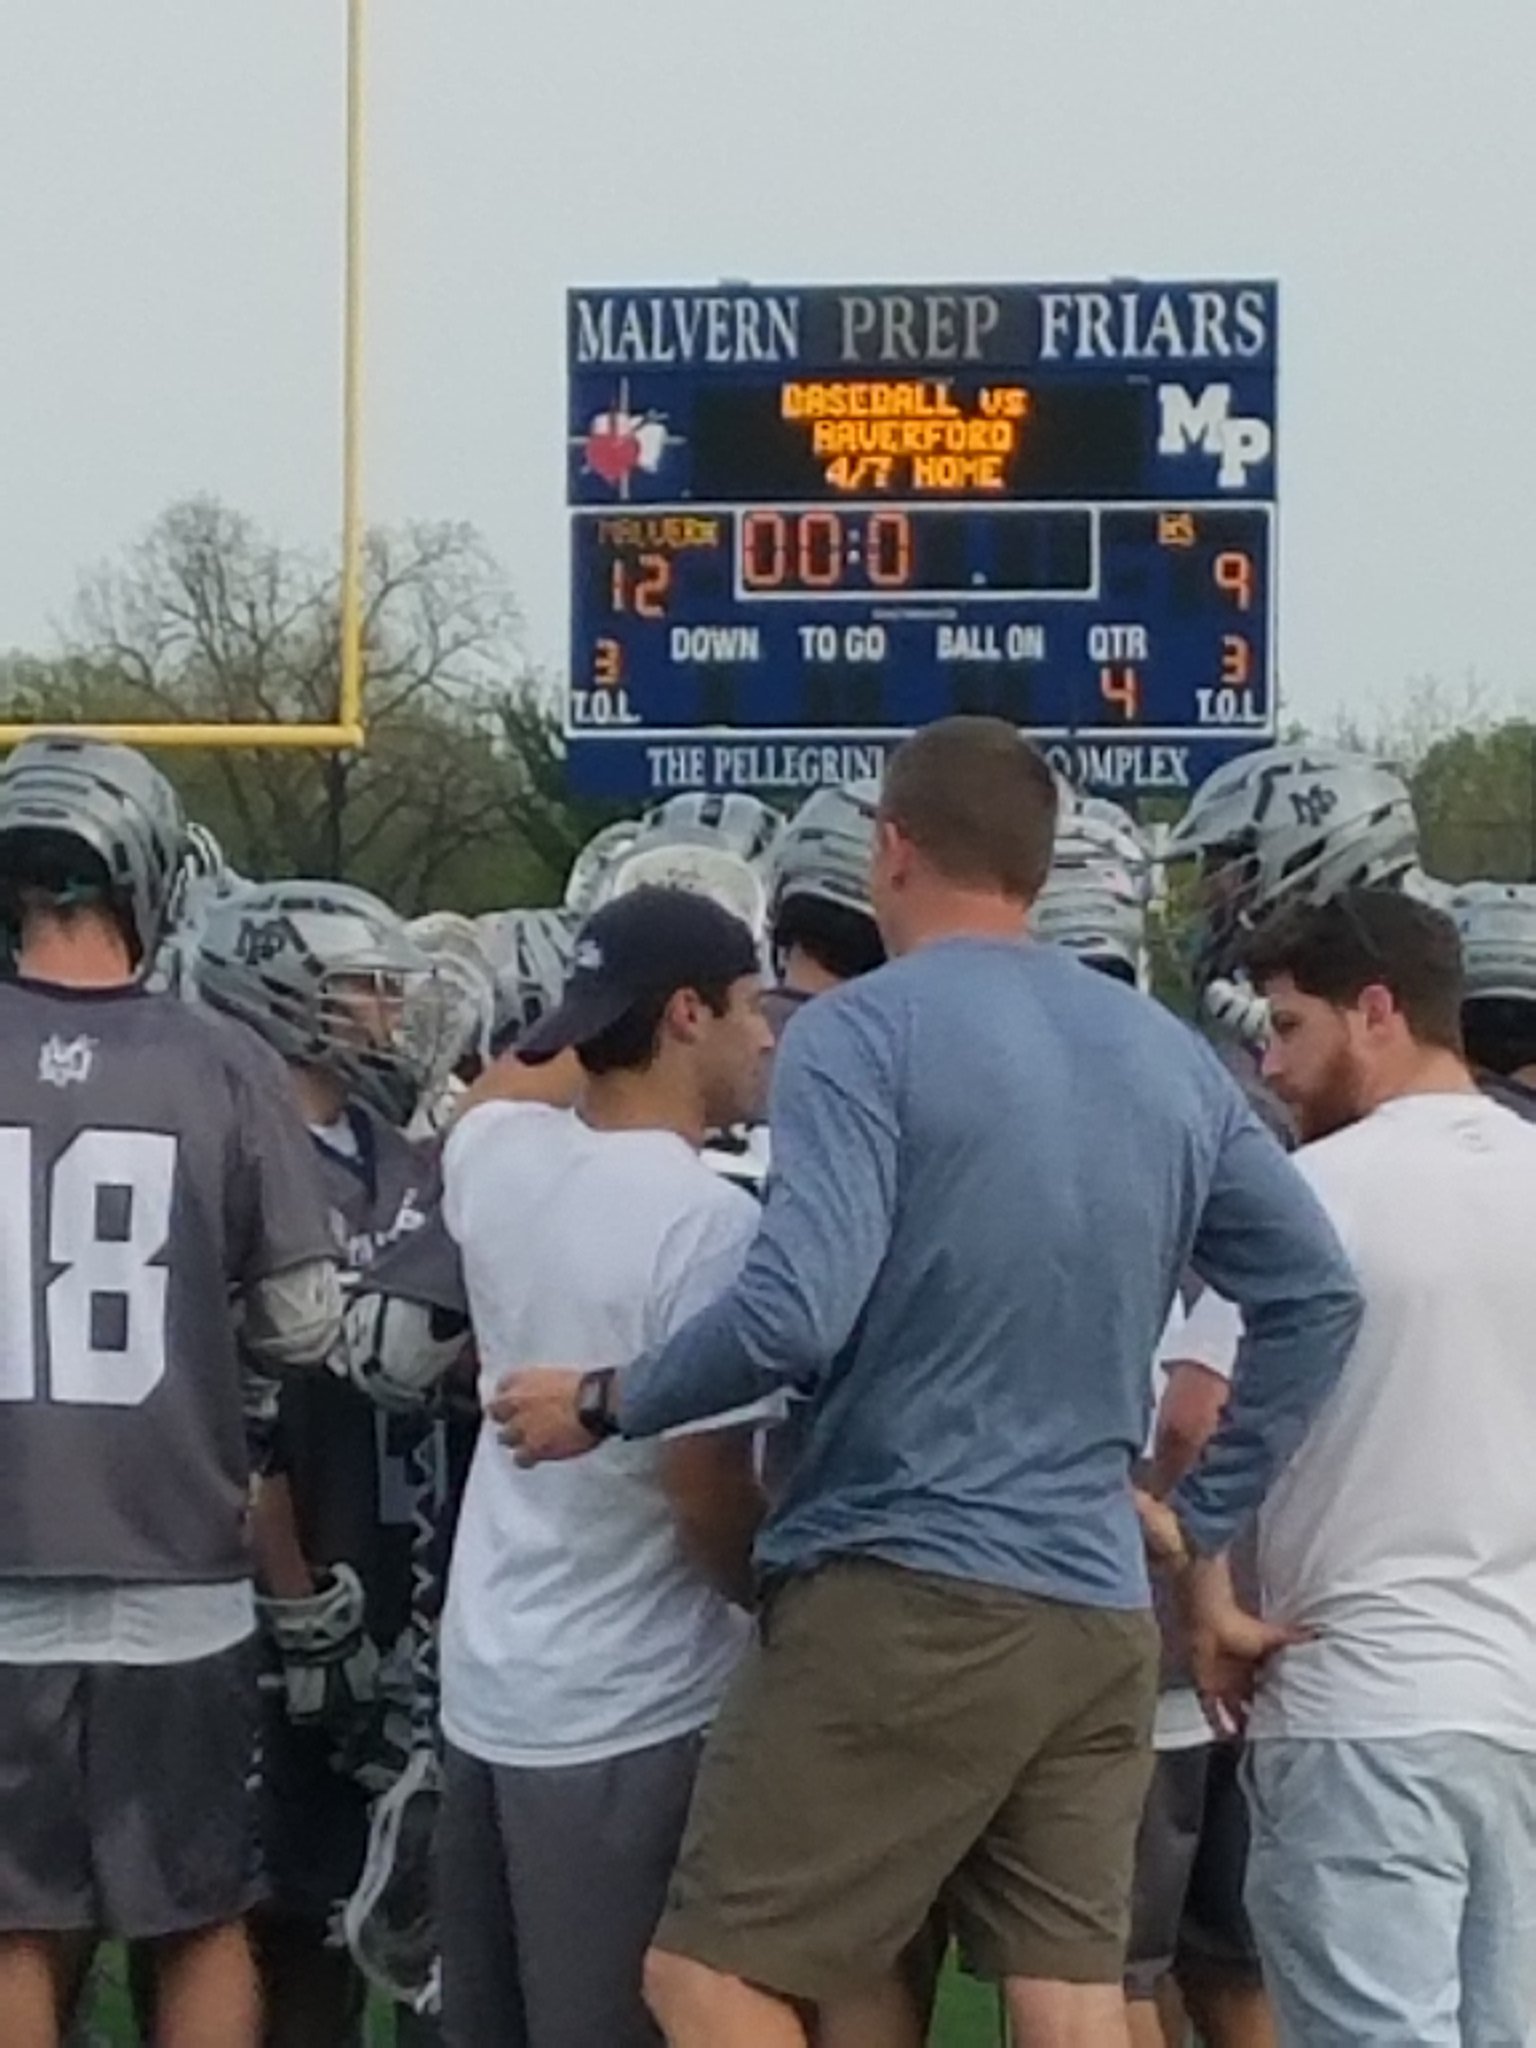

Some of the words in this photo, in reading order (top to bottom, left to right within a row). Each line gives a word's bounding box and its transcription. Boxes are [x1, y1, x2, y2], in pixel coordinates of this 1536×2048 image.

[576, 296, 799, 363] MALVERN
[839, 296, 1001, 361] PREP
[1038, 291, 1268, 358] FRIARS
[825, 454, 893, 489] 4/7
[913, 454, 1005, 488] HOME
[611, 553, 671, 618] 12
[1213, 551, 1251, 611] 9
[594, 637, 622, 686] 3
[670, 626, 760, 663] DOWN
[798, 625, 837, 662] TO
[845, 625, 886, 662] GO
[936, 624, 1003, 662] BALL
[1006, 624, 1045, 661] ON
[1088, 623, 1149, 662] QTR
[1220, 634, 1249, 684] 3
[1101, 667, 1136, 720] 4
[646, 745, 706, 787] THE
